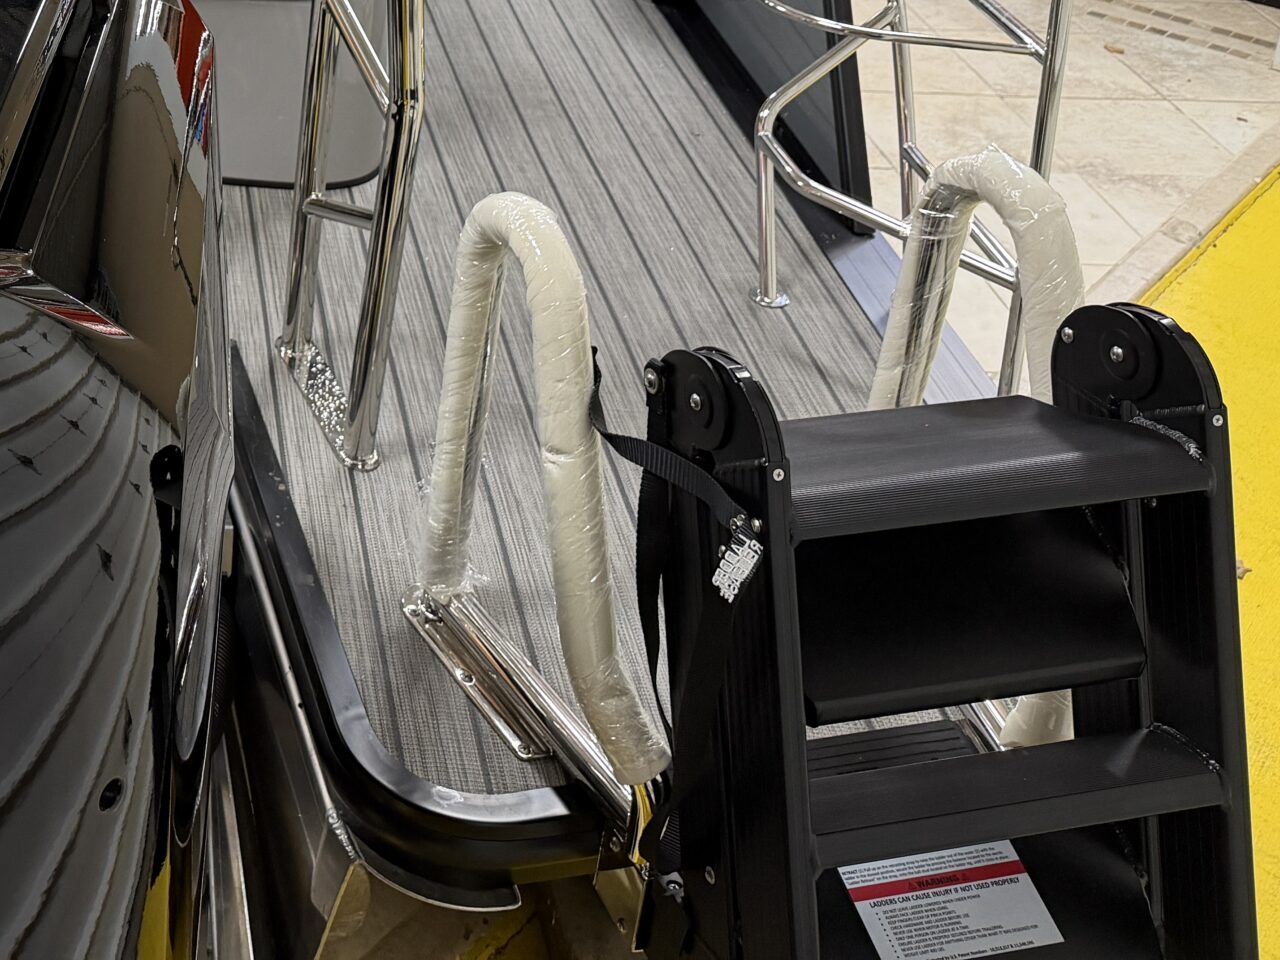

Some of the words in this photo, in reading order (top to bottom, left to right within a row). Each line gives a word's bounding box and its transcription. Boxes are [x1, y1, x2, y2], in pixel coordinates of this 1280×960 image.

[918, 876, 959, 888] WARNING
[870, 899, 896, 908] LADDERS
[912, 893, 930, 901] CAUSE
[932, 889, 953, 897] INJURY
[961, 885, 974, 893] NOT
[991, 878, 1020, 887] PROPERLY
